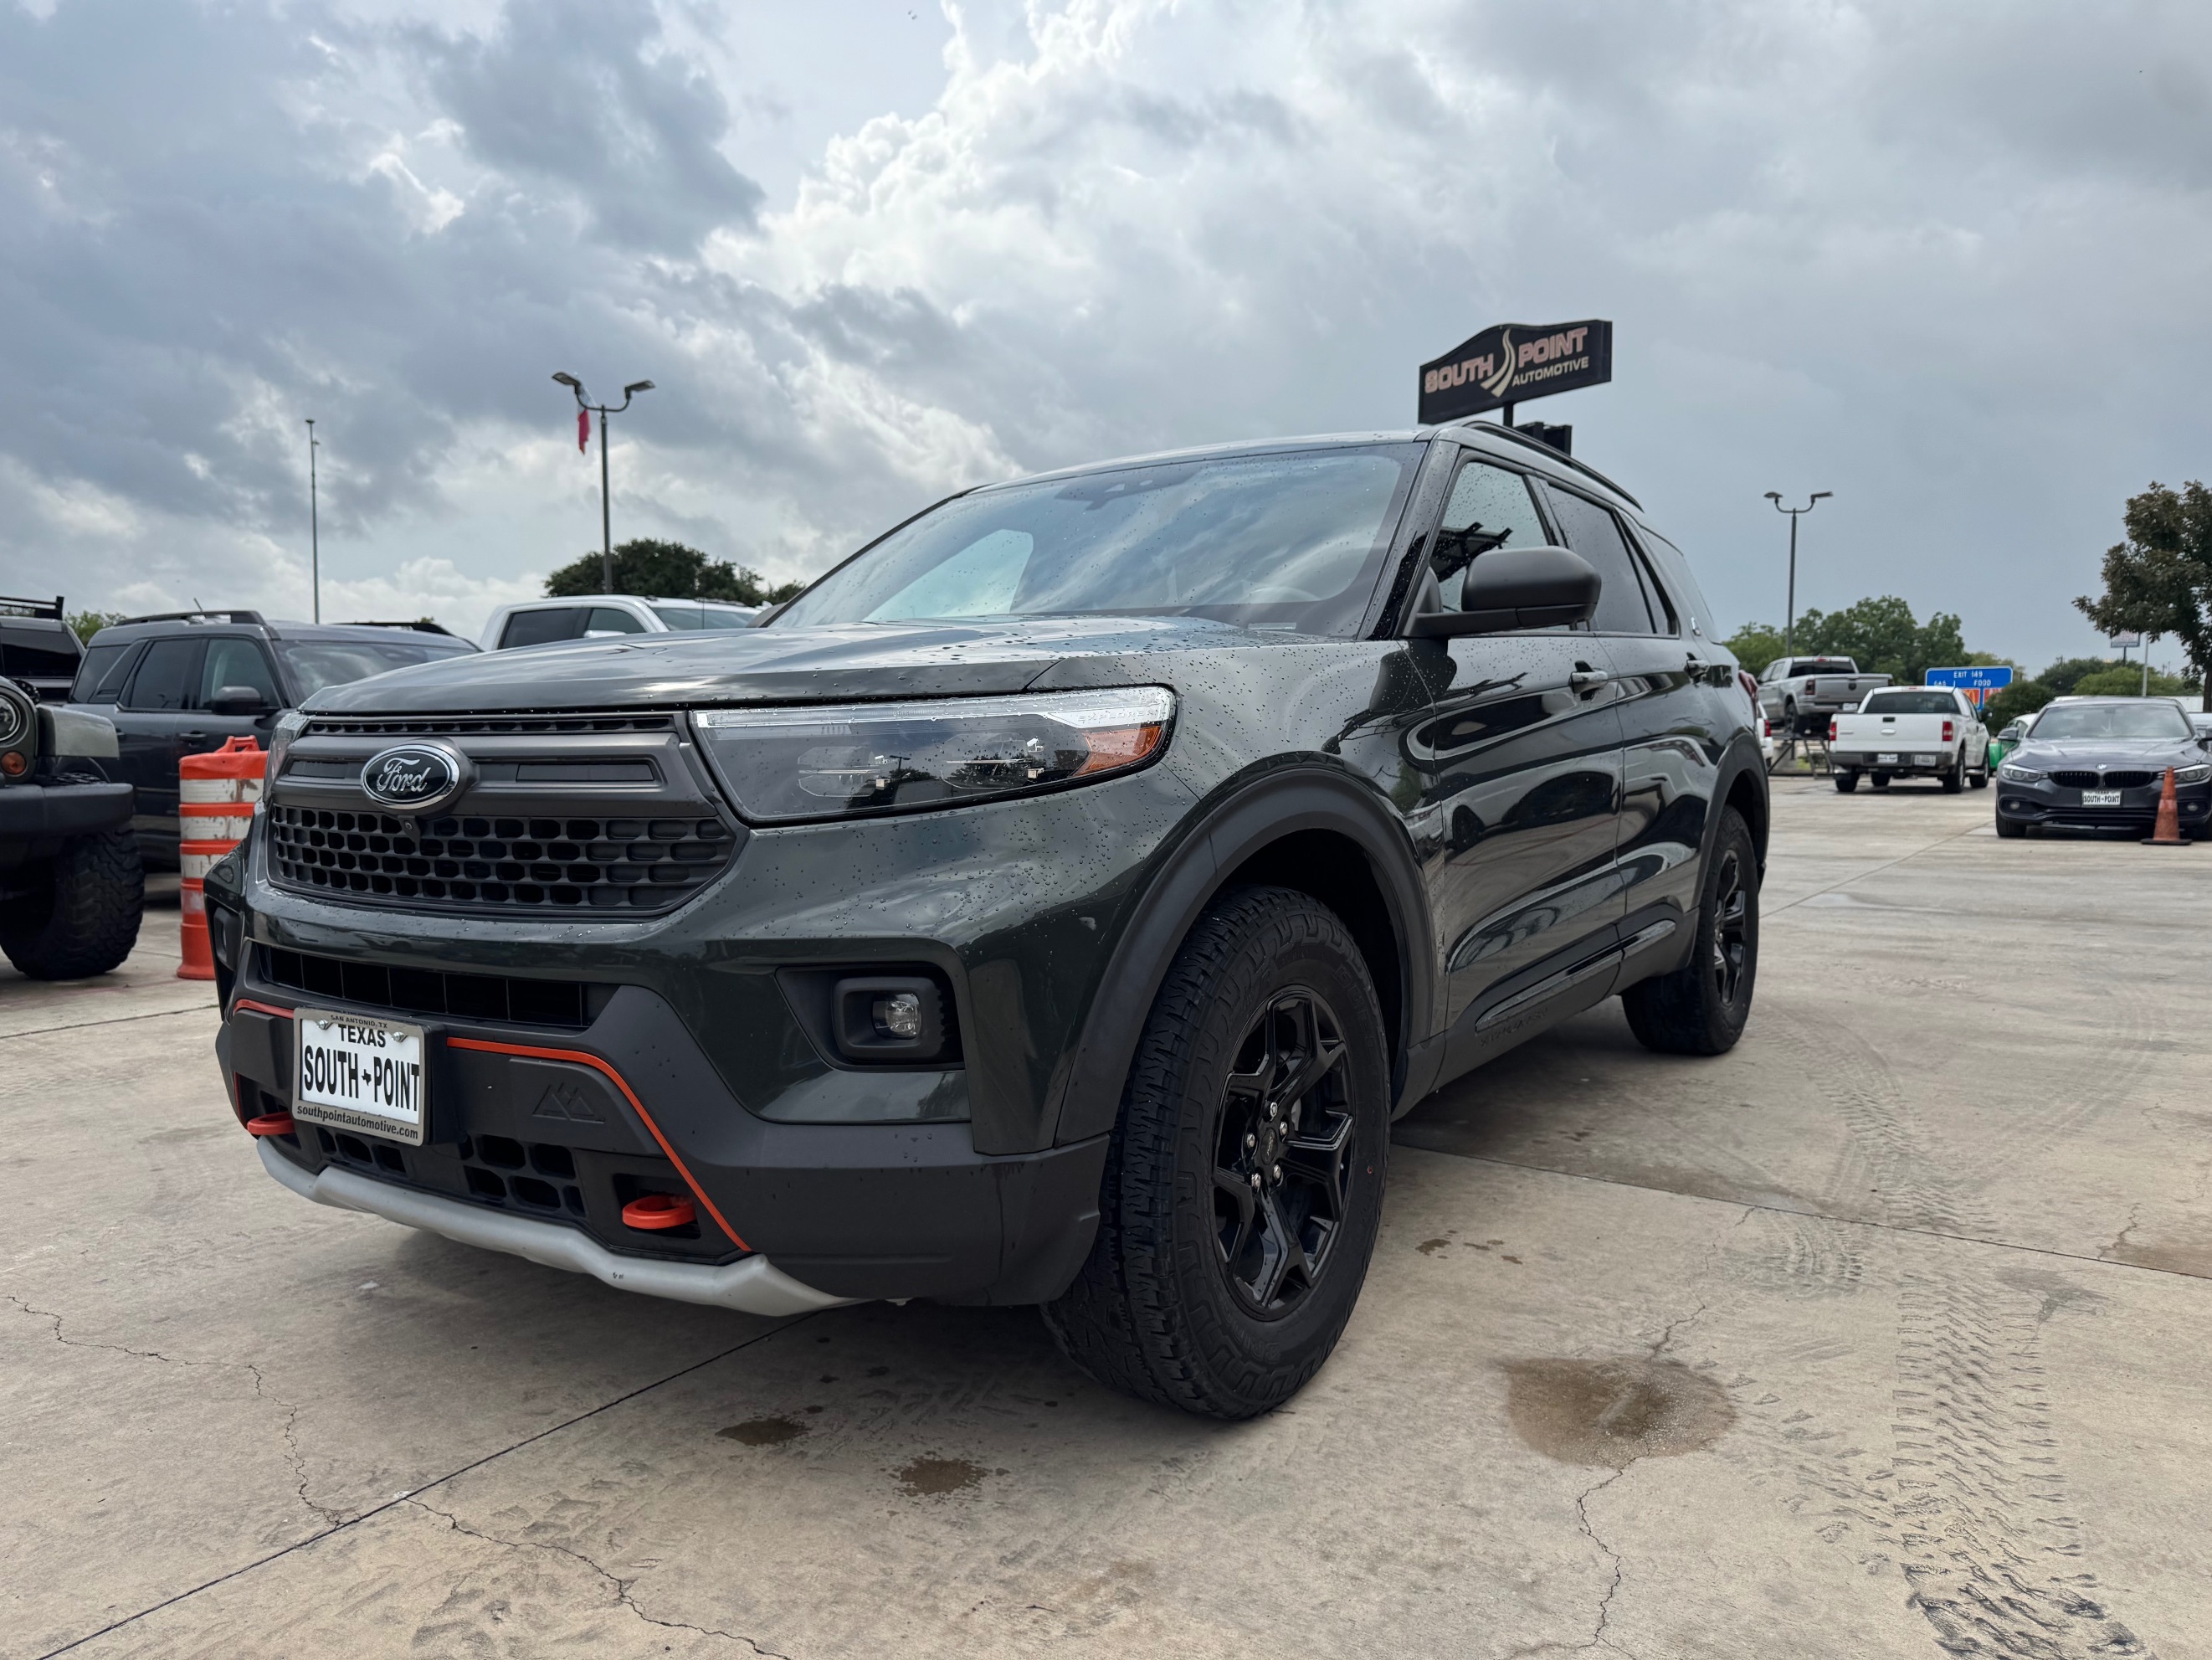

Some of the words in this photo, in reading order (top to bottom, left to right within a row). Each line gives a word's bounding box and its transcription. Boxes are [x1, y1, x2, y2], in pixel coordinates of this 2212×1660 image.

[1424, 352, 1494, 394] SOUTH
[1517, 326, 1588, 368] POINT
[1511, 356, 1589, 388] AUTOMOTIVE
[1953, 671, 1968, 679] EXIT
[376, 757, 432, 793] Ford
[2083, 794, 2101, 804] SOUTH
[2104, 794, 2120, 804] POINT
[337, 1024, 387, 1048] TEXAS
[304, 1045, 359, 1099] SOUTH
[373, 1056, 420, 1112] POINT
[297, 1104, 418, 1139] southpointautomotive.com
